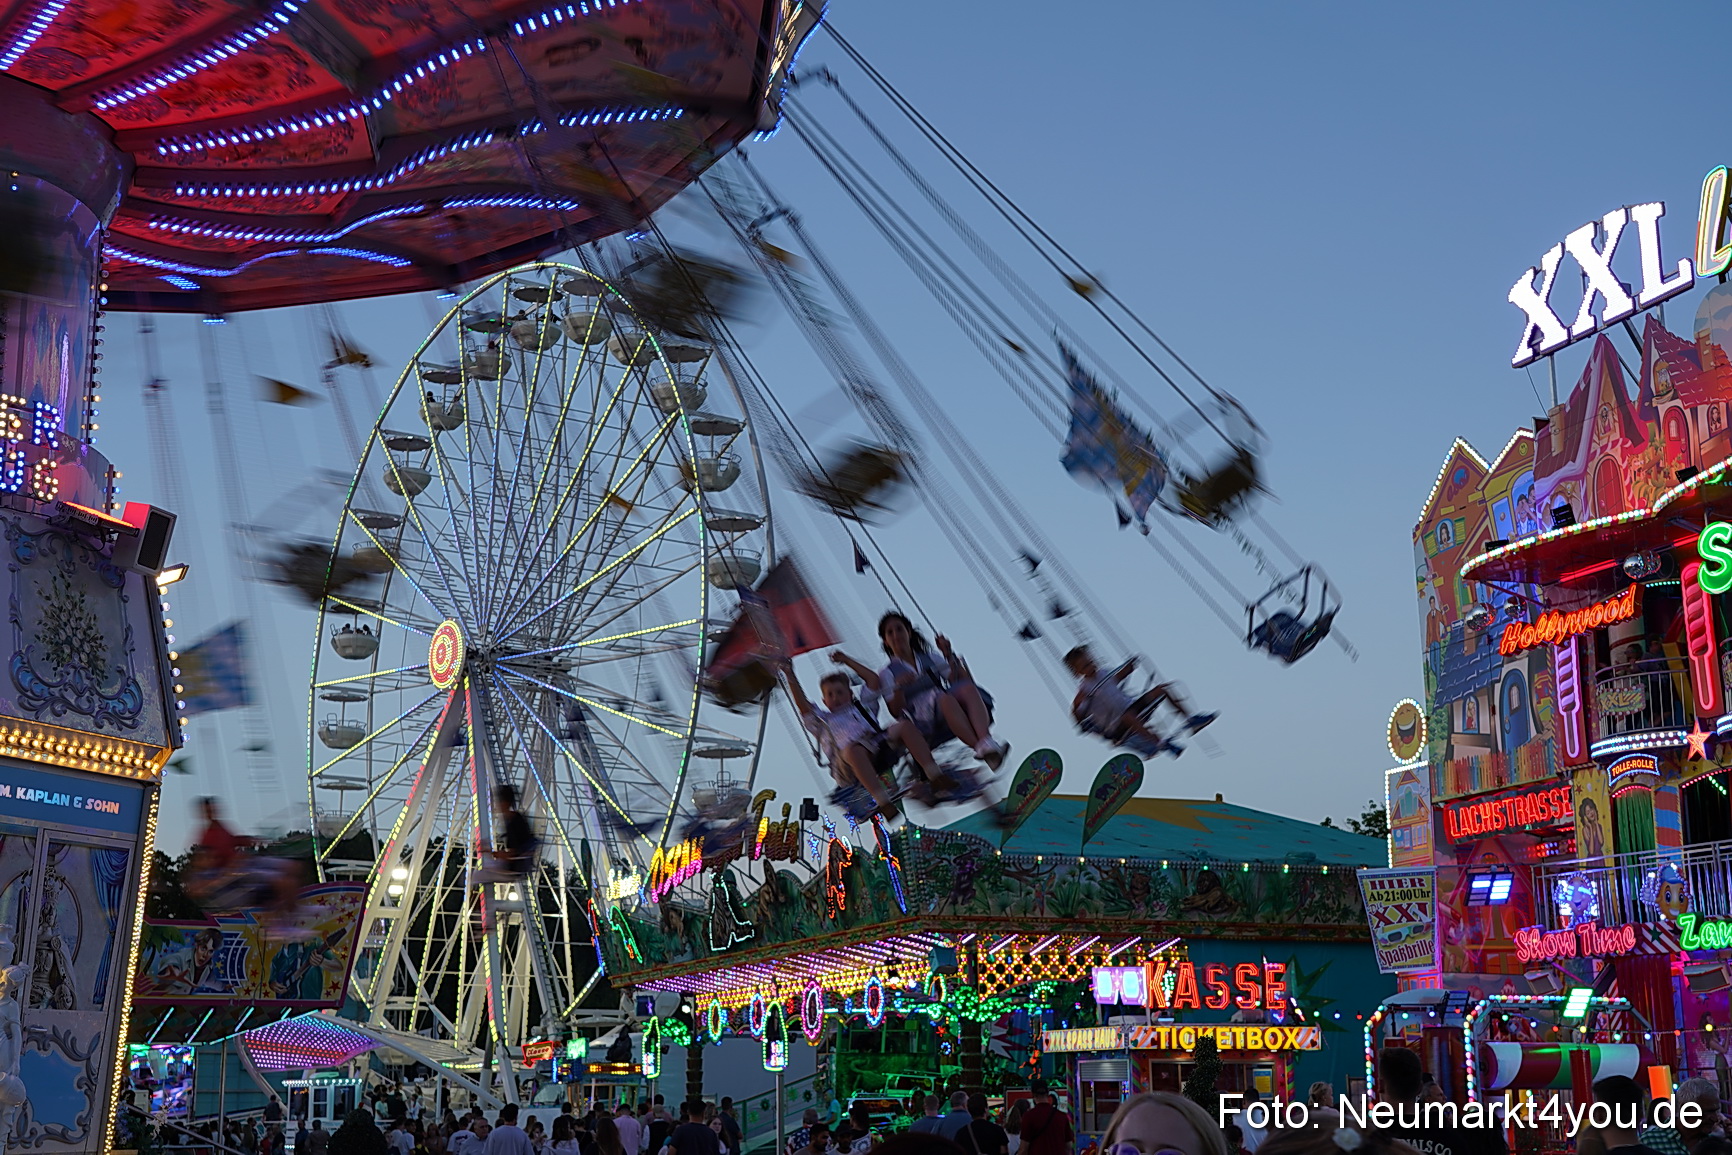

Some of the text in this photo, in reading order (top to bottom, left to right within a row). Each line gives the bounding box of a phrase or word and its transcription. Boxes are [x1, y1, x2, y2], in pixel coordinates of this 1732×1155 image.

[1507, 202, 1695, 367] XXL
[1499, 582, 1638, 656] Hollywood
[1611, 758, 1654, 777] TOLLE-ROLLE
[16, 786, 70, 807] KAPLAN
[73, 796, 83, 809] &
[85, 798, 120, 815] SOHN
[1448, 785, 1574, 838] LACHSTRASSE
[1368, 878, 1426, 890] HIER
[1369, 888, 1431, 902] Ab 21:00 Uhr
[1514, 920, 1636, 963] Show Time
[1143, 960, 1288, 1011] KASSE
[1050, 1028, 1116, 1050] XXL SPASS HAUS
